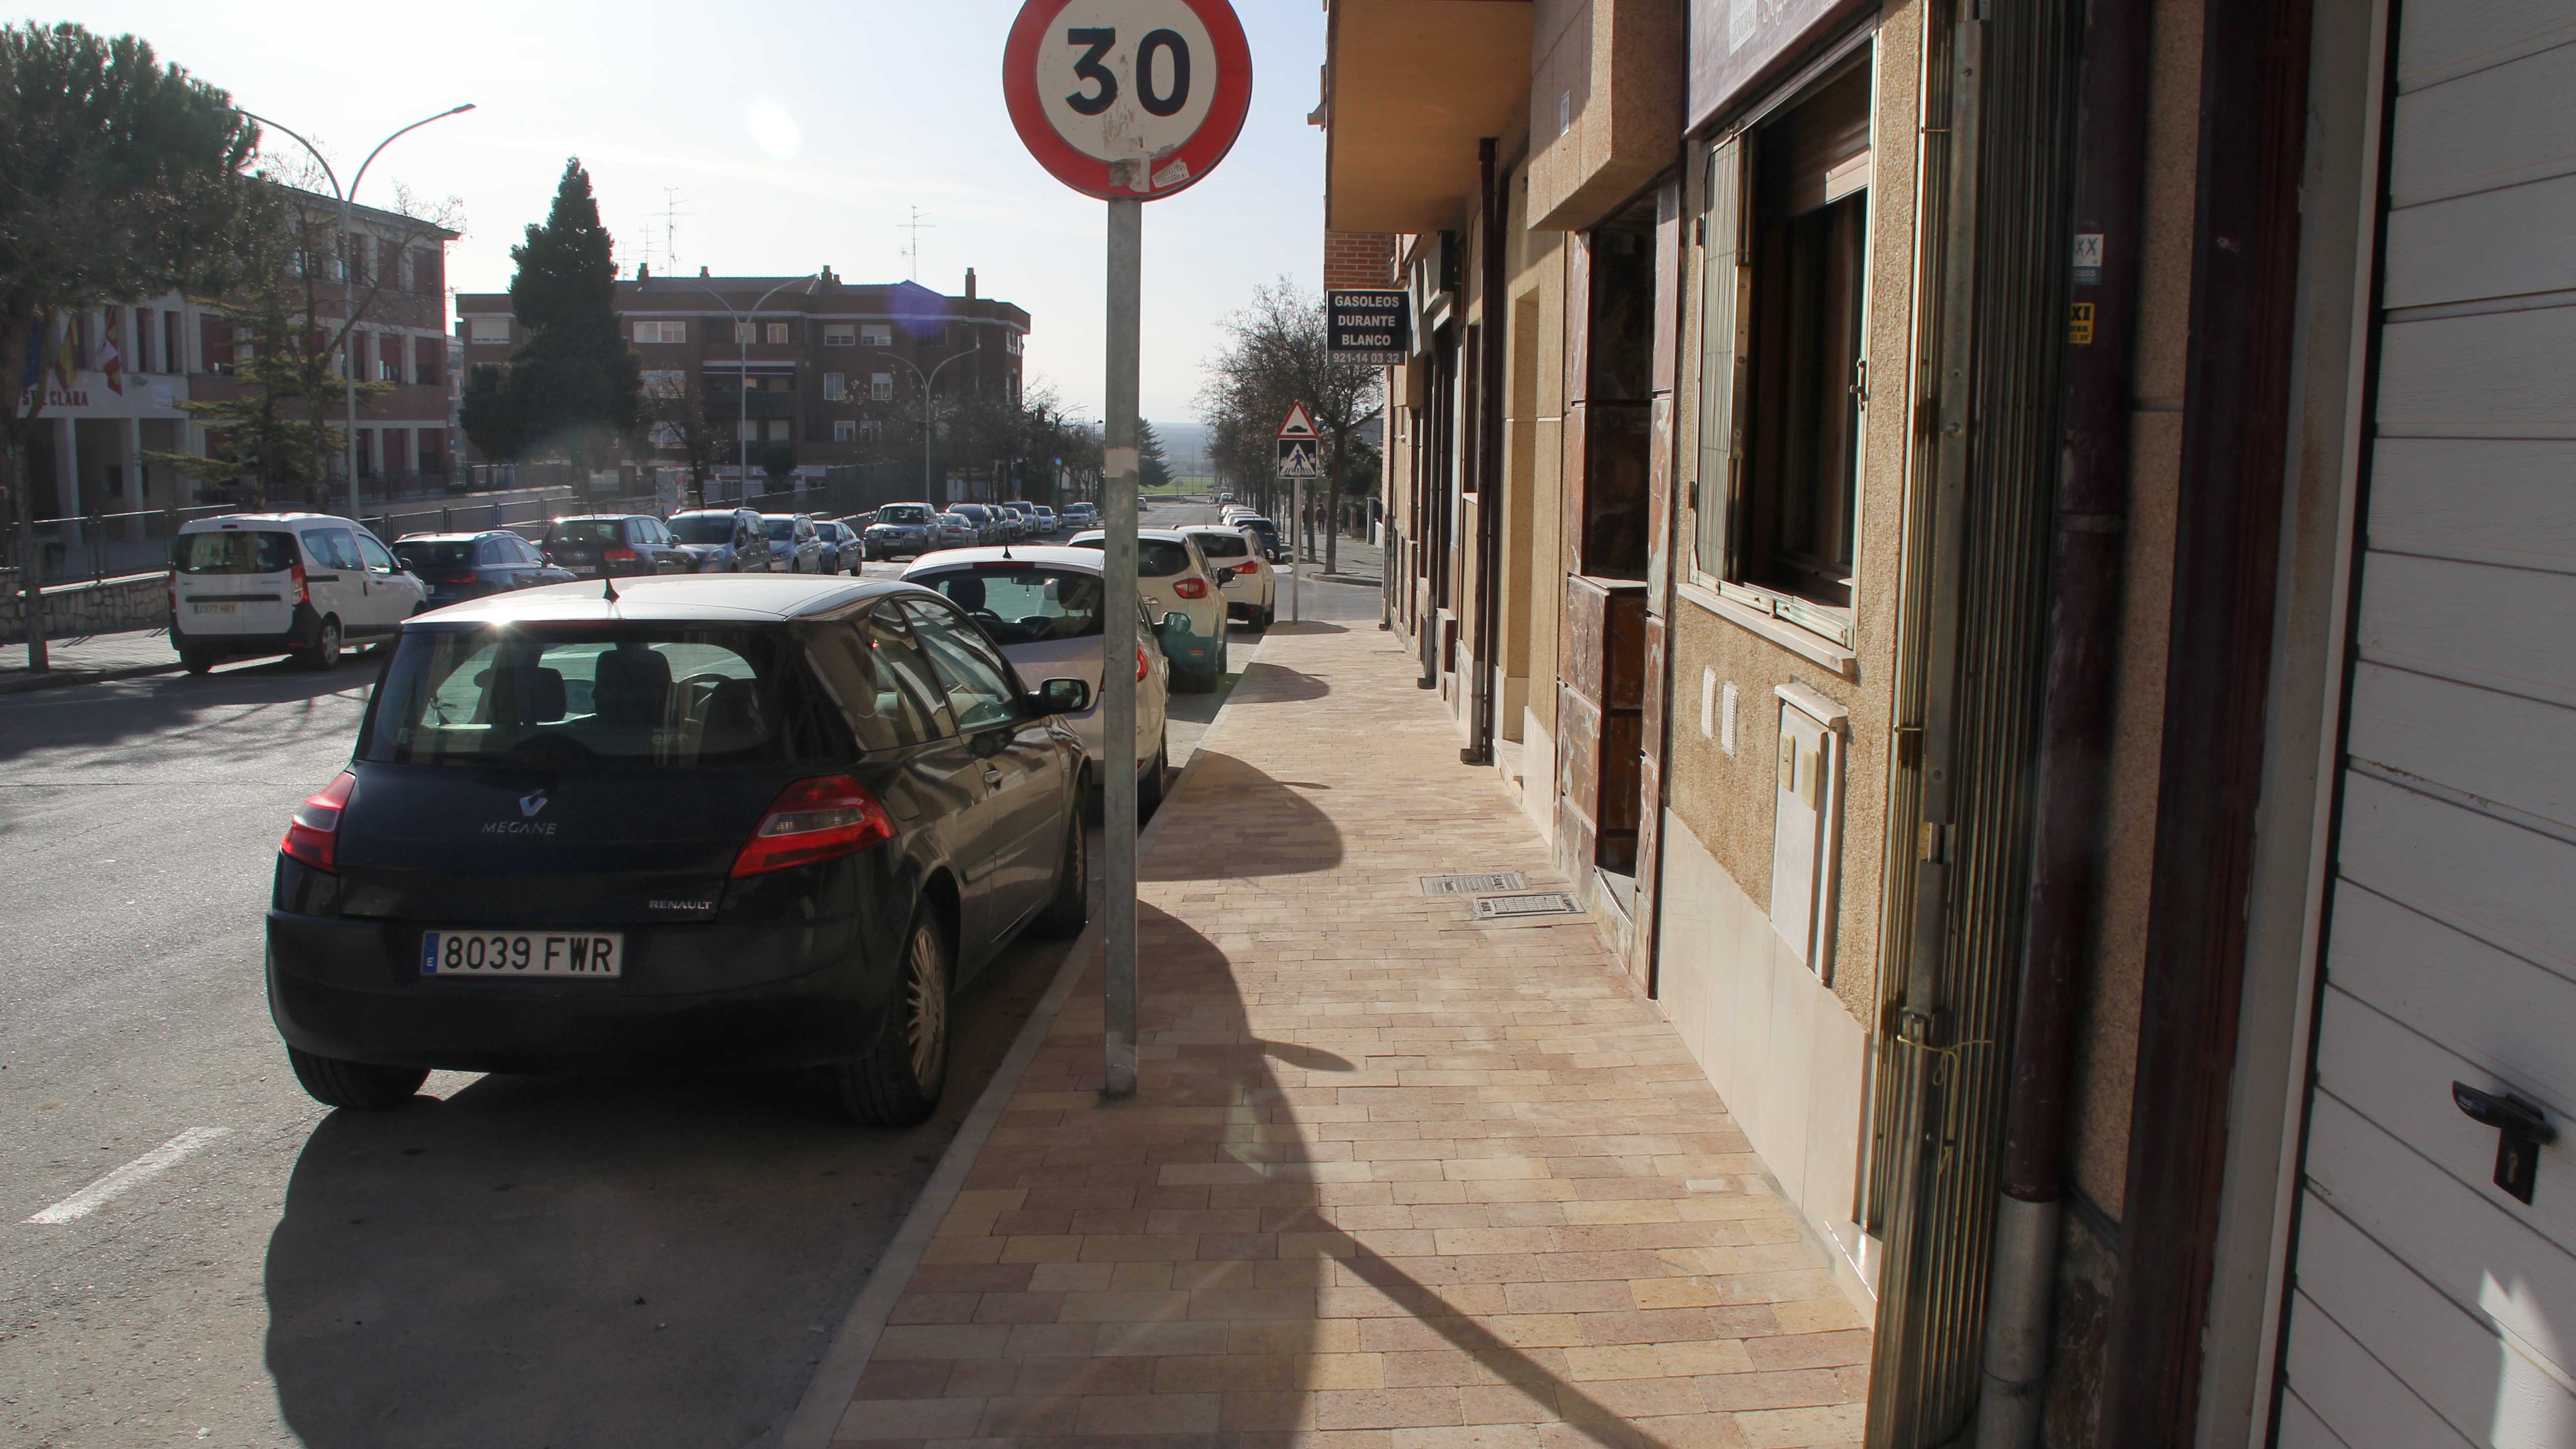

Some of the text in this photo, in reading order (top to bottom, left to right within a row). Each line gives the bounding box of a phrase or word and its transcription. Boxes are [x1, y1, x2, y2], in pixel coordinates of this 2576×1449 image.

[1066, 28, 1191, 117] 30
[1334, 295, 1400, 308] GASOLEOS
[1338, 315, 1396, 326] DURANTE
[1342, 334, 1391, 346] BLANCO
[1333, 353, 1399, 363] 921-14 03 32
[50, 390, 88, 406] CLARA
[481, 821, 557, 834] MEGANE
[649, 900, 712, 909] RENAULT
[426, 936, 613, 972] E 8039 FWR
